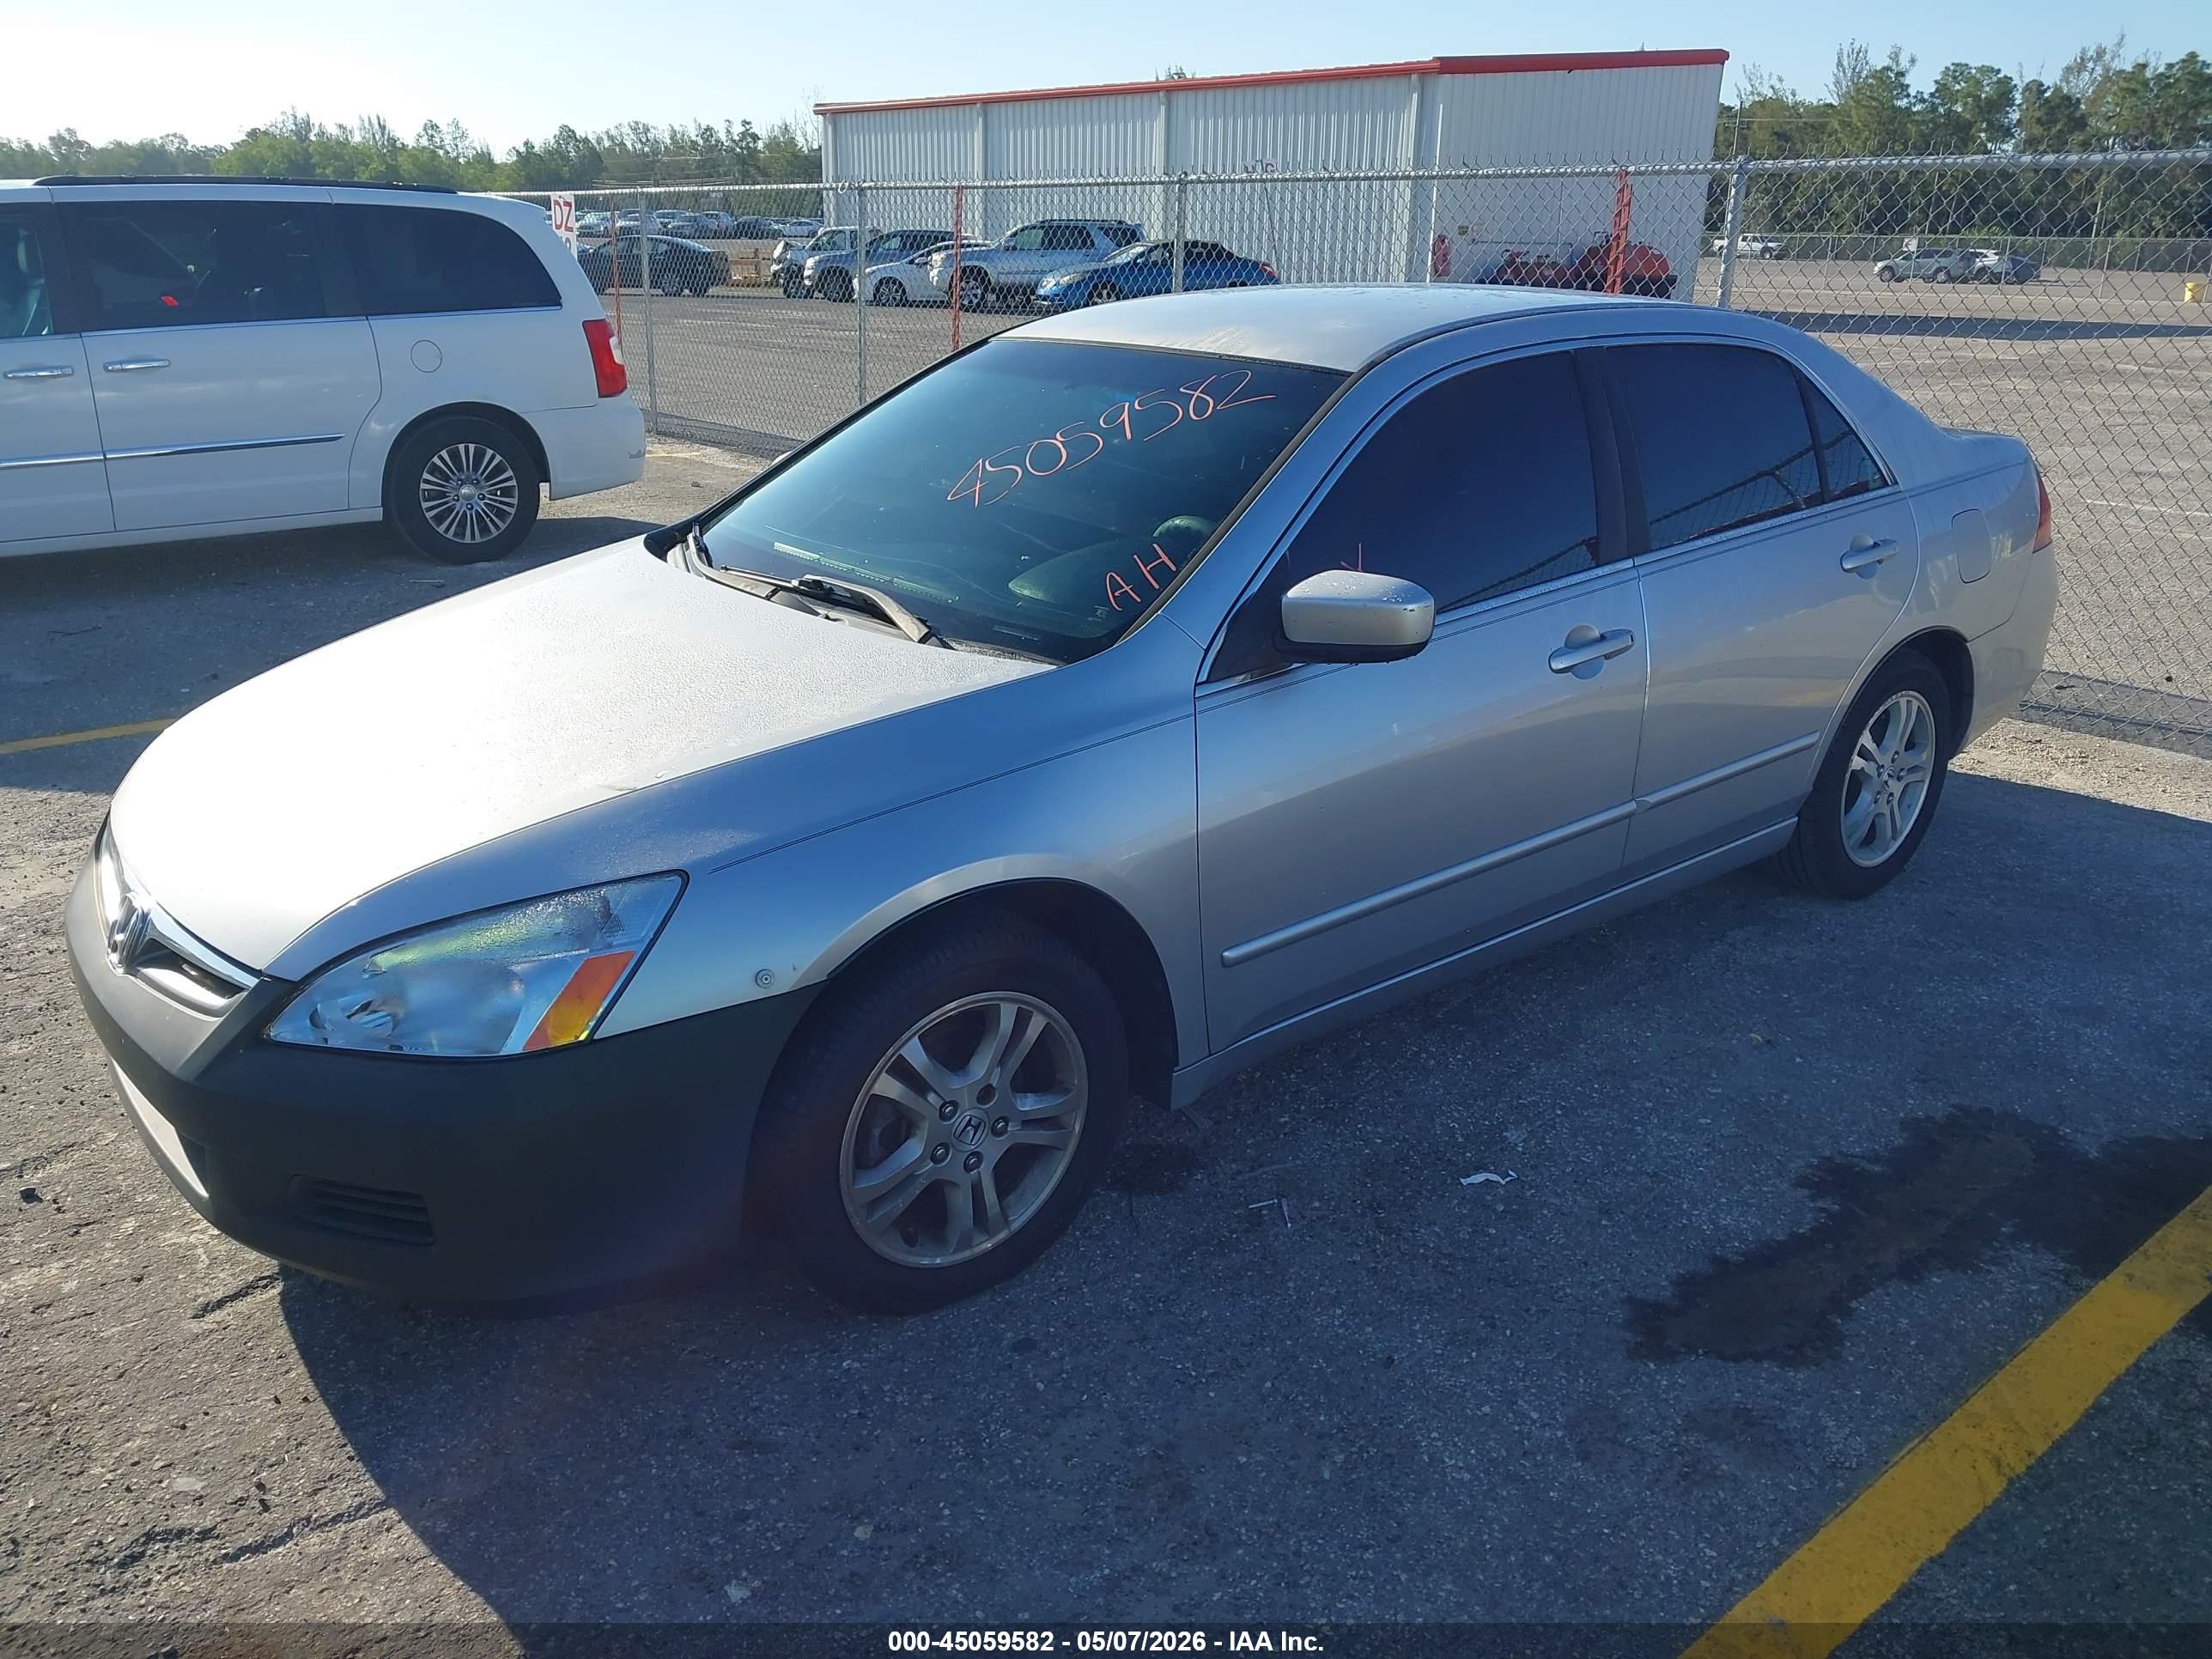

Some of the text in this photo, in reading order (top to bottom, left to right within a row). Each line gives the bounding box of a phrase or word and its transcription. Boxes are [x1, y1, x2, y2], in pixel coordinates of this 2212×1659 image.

[553, 199, 574, 233] DZ
[946, 370, 1277, 508] 45059582
[1105, 543, 1177, 611] AH
